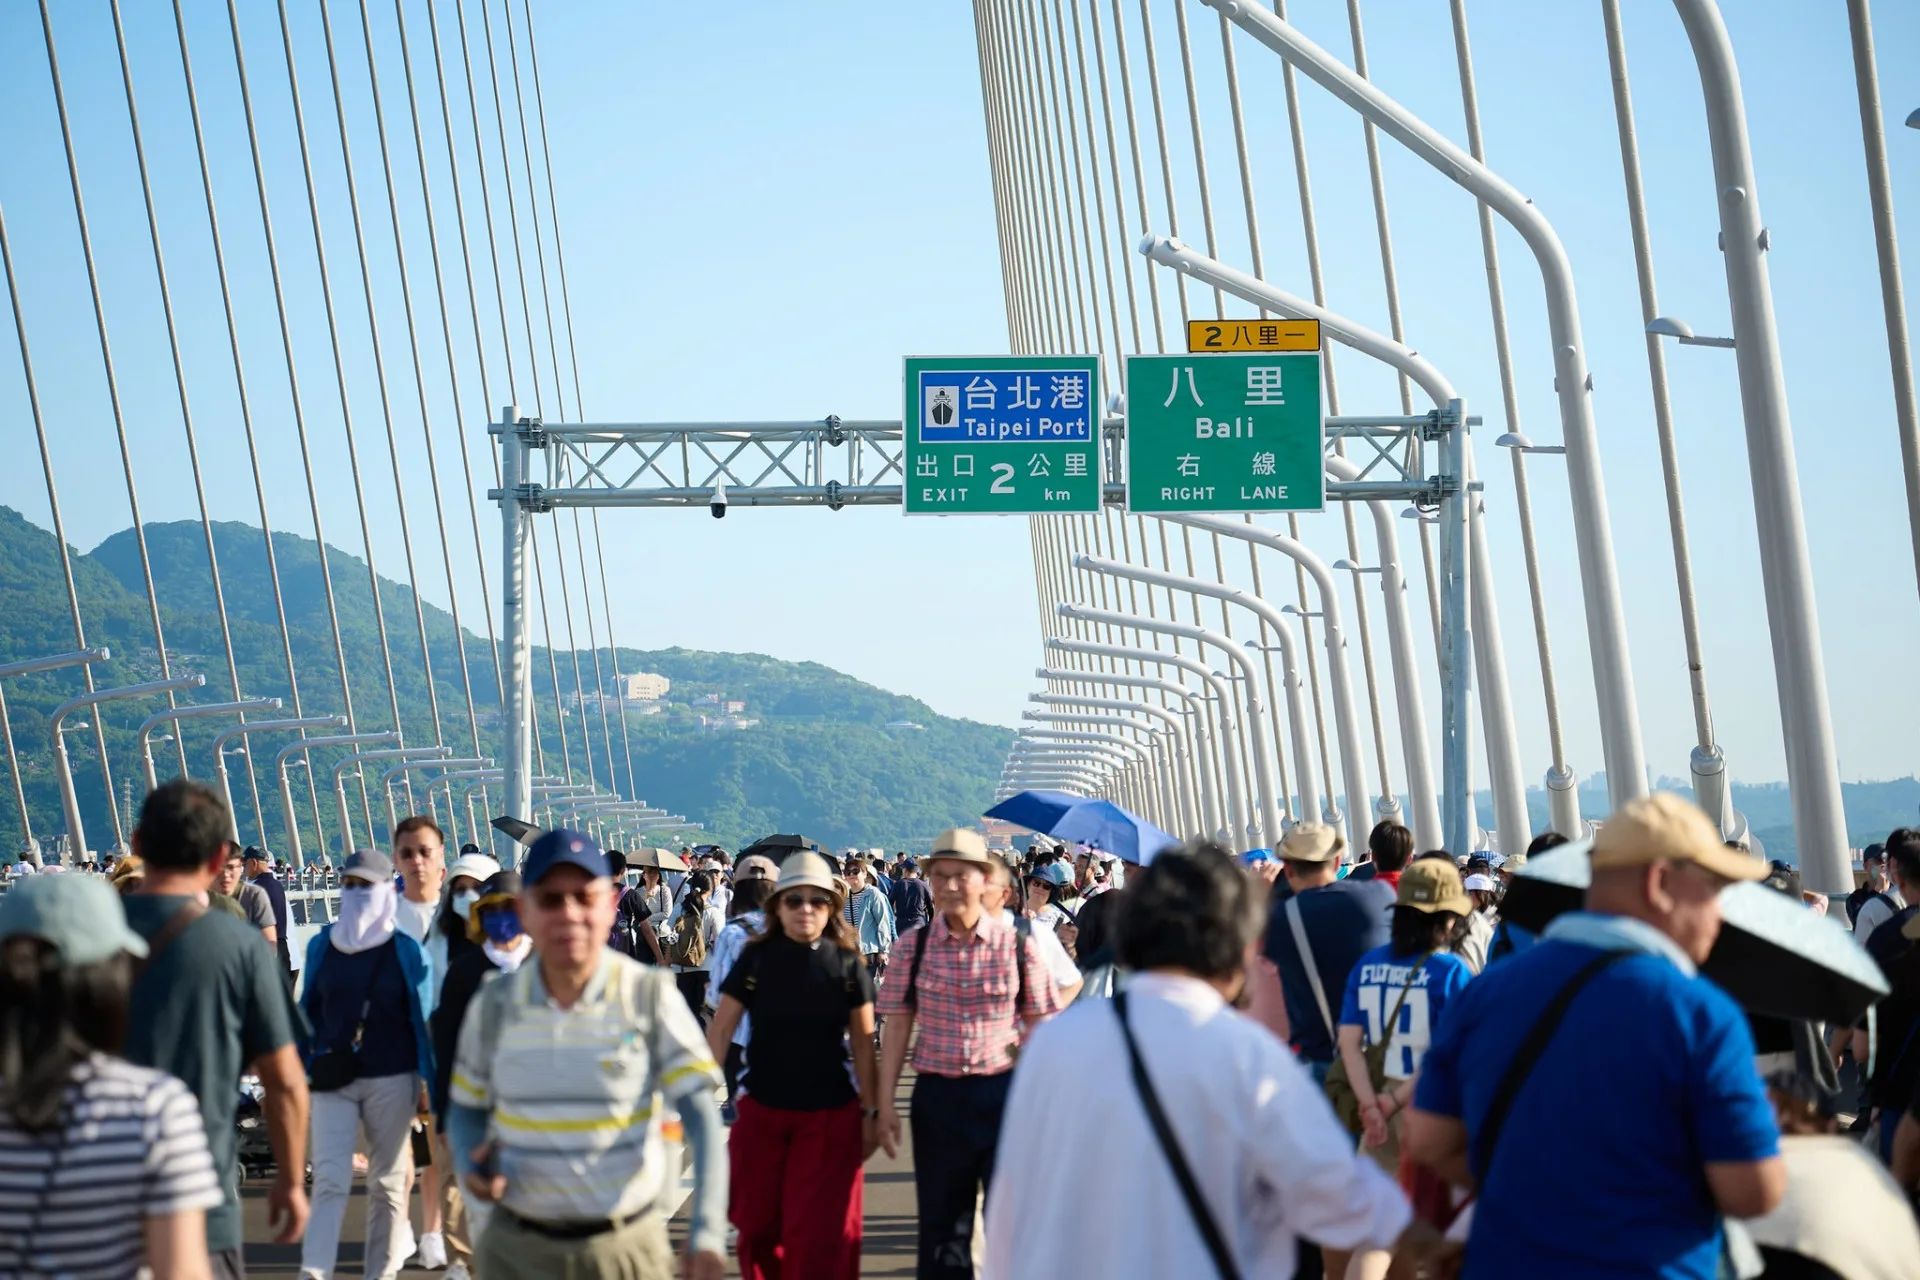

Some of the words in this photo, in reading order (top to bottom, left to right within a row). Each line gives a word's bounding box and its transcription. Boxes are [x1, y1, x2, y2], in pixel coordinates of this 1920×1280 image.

[964, 375, 1085, 411] 台北港
[1164, 366, 1285, 408] 八里
[964, 418, 1031, 440] Taipei
[1038, 418, 1085, 437] Port
[1196, 416, 1254, 439] Bali
[916, 453, 974, 477] 出口
[990, 462, 1015, 494] 2
[1027, 453, 1088, 477] 公里
[1176, 452, 1276, 477] 右線
[923, 488, 968, 502] EXIT
[1044, 488, 1070, 501] km
[1161, 486, 1215, 501] RIGHT
[1241, 486, 1289, 500] LANE
